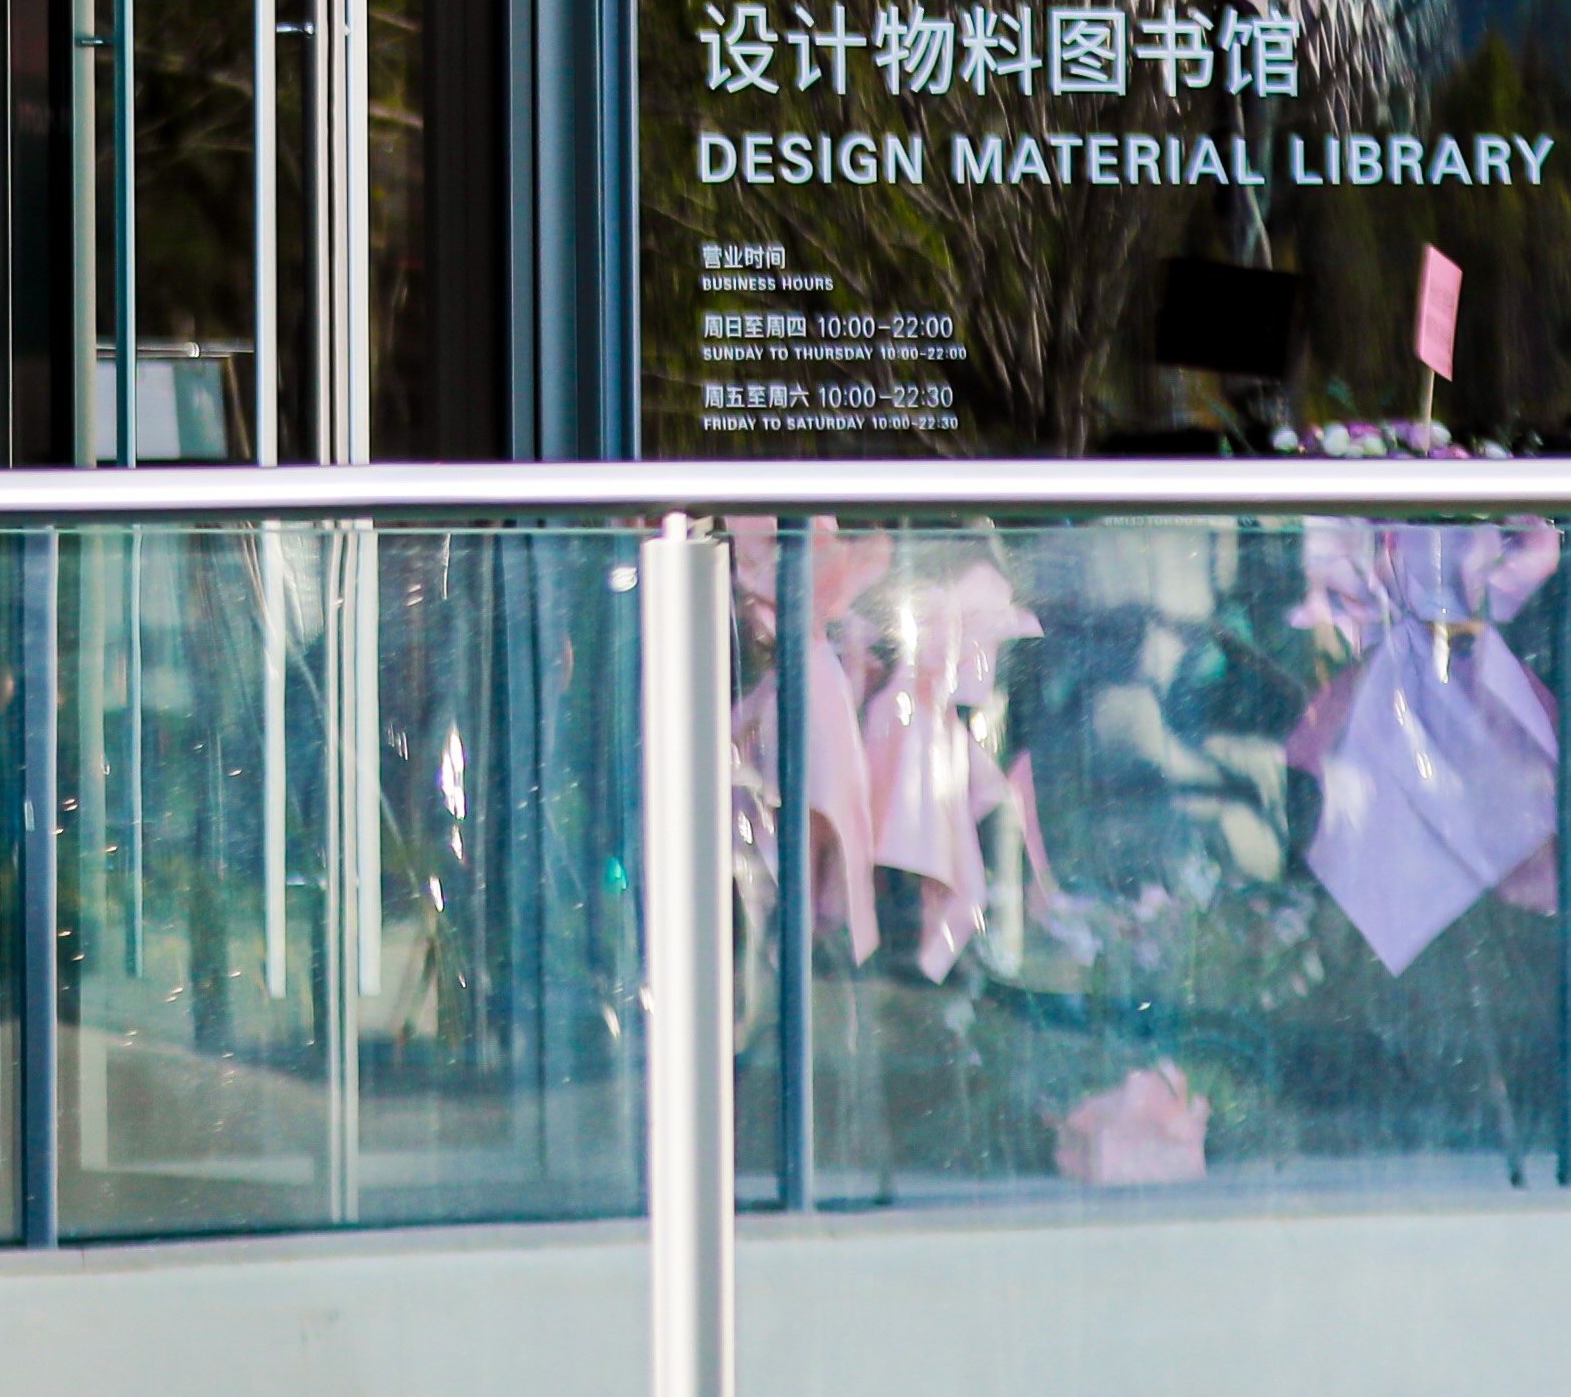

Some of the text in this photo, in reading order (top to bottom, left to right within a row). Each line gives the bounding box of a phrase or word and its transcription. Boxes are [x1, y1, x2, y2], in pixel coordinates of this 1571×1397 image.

[699, 2, 1301, 99] 设计物料图书馆
[700, 134, 1555, 186] DESIGN MATERIAL LIBRARY
[702, 244, 786, 270] 营业时间
[702, 275, 834, 292] BUSINESS HOURS
[703, 314, 954, 339] 周日至周四 10:00-22:00
[703, 346, 967, 361] SUNDAY TO THURSDAY 10:00-22:00
[704, 383, 954, 409] 周五至周六 10:00-22:30
[703, 415, 757, 431] FRIDAY
[762, 415, 781, 431] TO
[787, 415, 865, 431] SATURDAY
